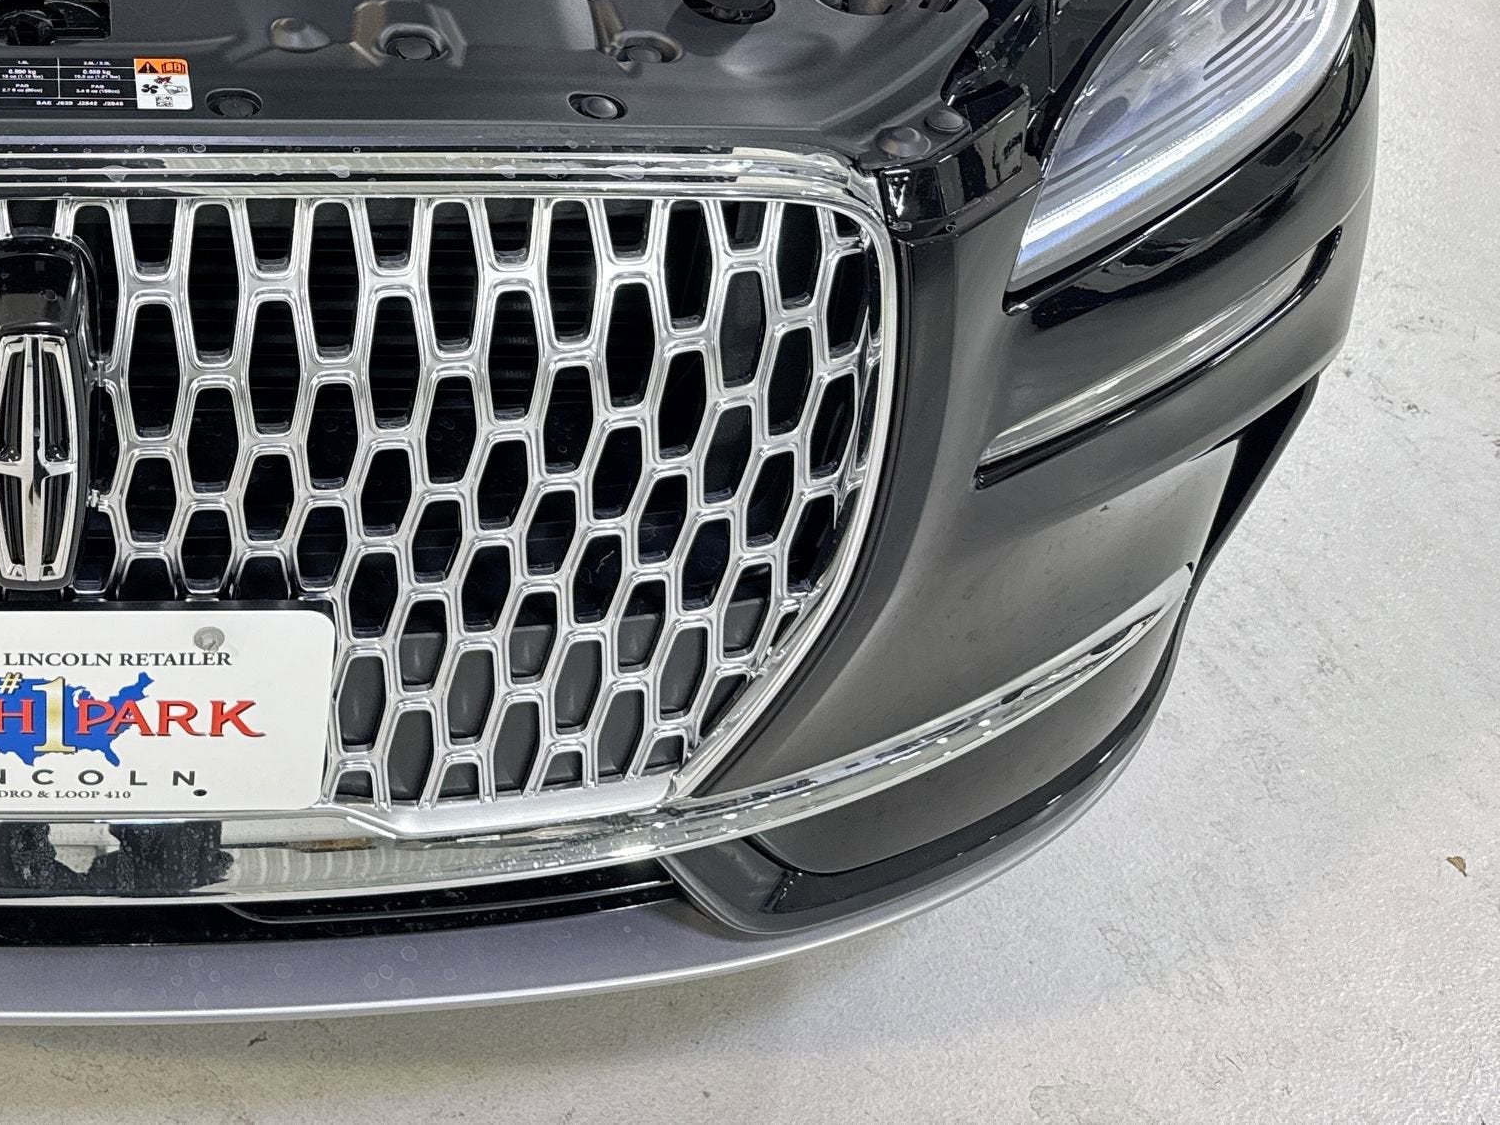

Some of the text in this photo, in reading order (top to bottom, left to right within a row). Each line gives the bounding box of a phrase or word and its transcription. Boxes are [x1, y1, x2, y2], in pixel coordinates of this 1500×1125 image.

[4, 652, 113, 667] LINCOLN
[119, 652, 233, 666] RETAILER
[75, 699, 267, 738] PARK
[37, 789, 50, 799] &
[55, 790, 100, 799] LOOP
[104, 790, 132, 800] 410
